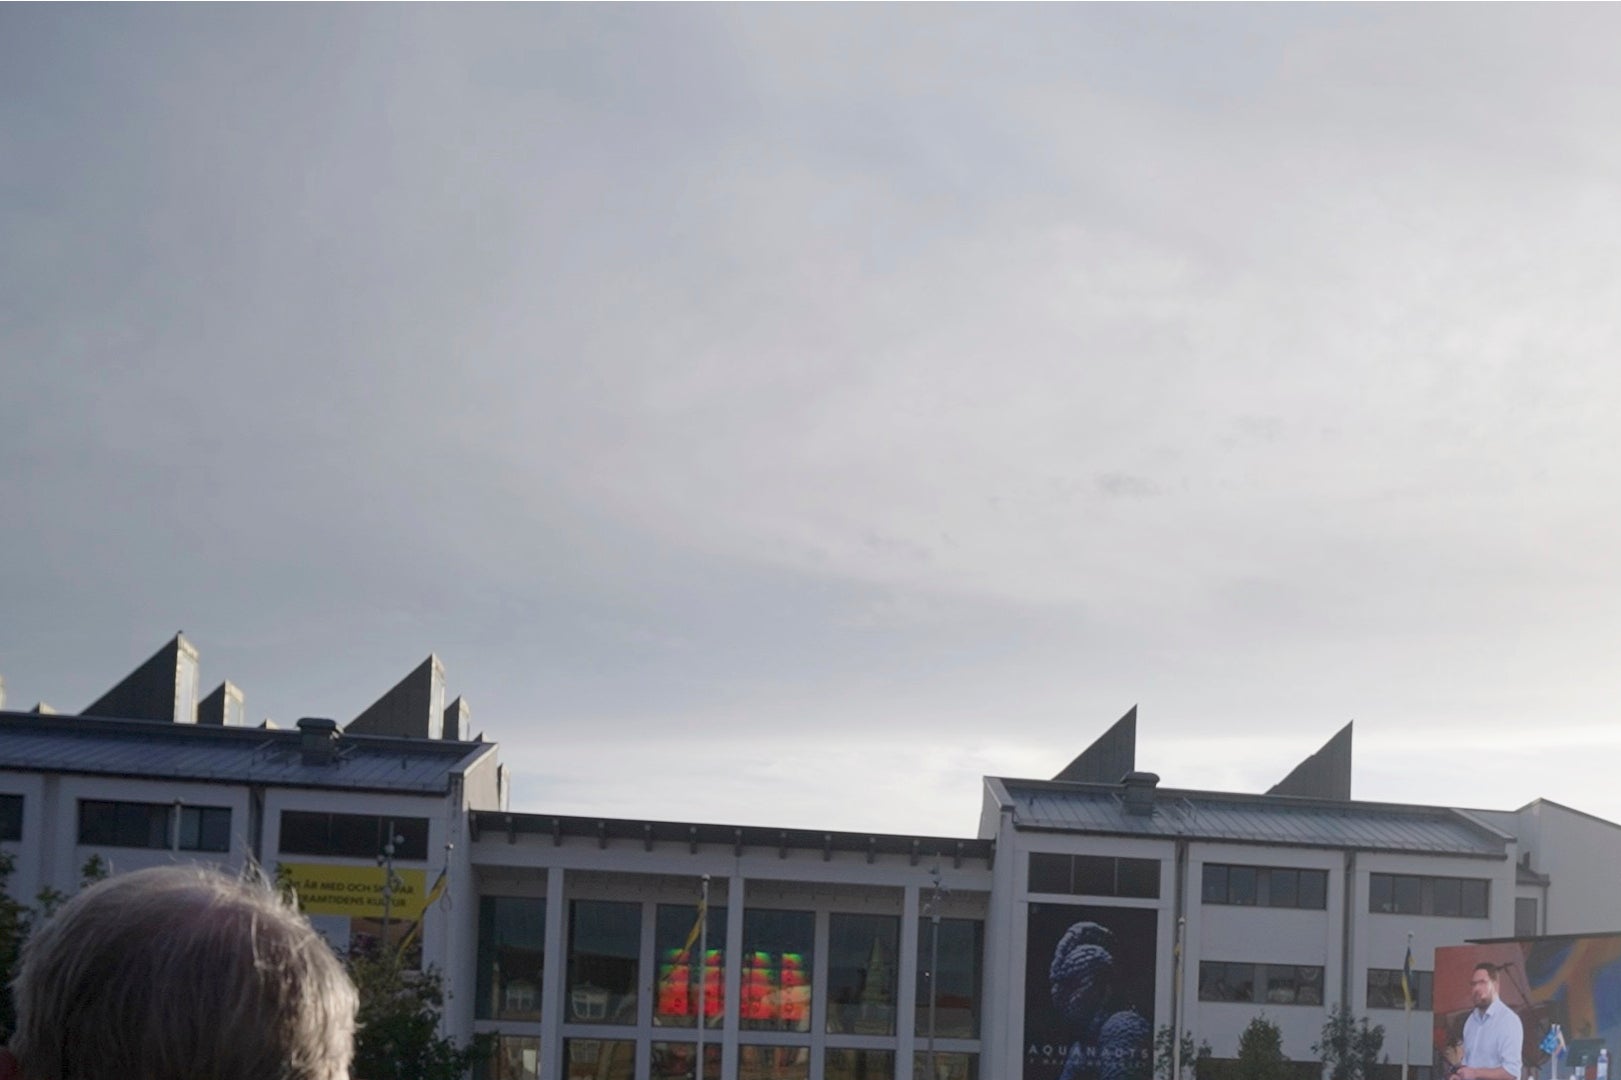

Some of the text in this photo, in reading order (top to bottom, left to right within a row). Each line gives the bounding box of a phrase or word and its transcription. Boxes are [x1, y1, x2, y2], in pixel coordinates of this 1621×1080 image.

[320, 882, 345, 892] MED
[347, 883, 371, 893] OCH
[367, 897, 406, 907] KULUR
[1028, 1044, 1149, 1059] AQUANAUTS
